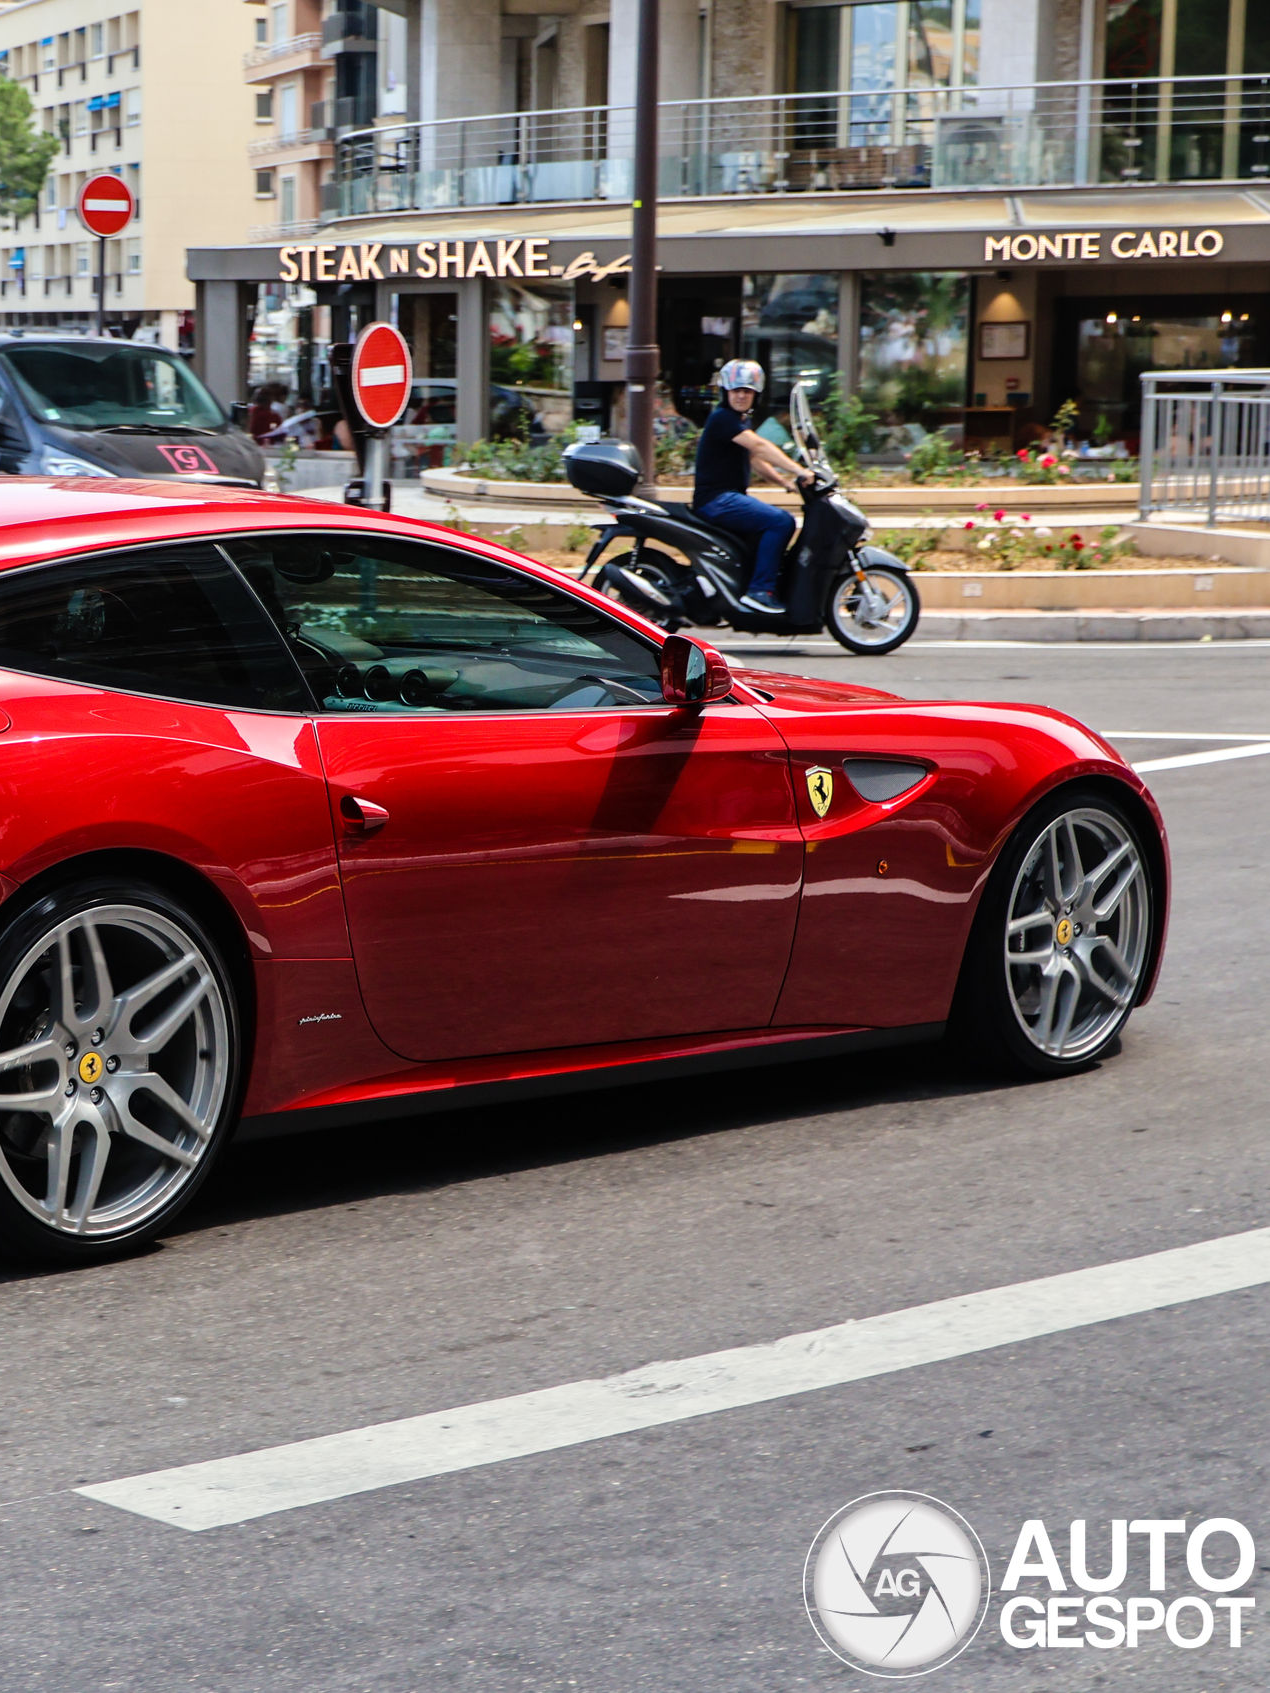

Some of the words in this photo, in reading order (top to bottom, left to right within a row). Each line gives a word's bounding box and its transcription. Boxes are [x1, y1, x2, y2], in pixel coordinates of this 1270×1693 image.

[279, 244, 385, 282] STEAK
[389, 248, 410, 273] N
[415, 238, 550, 279] SHAKE
[984, 232, 1101, 261] MONTE
[1110, 229, 1224, 259] CARLO
